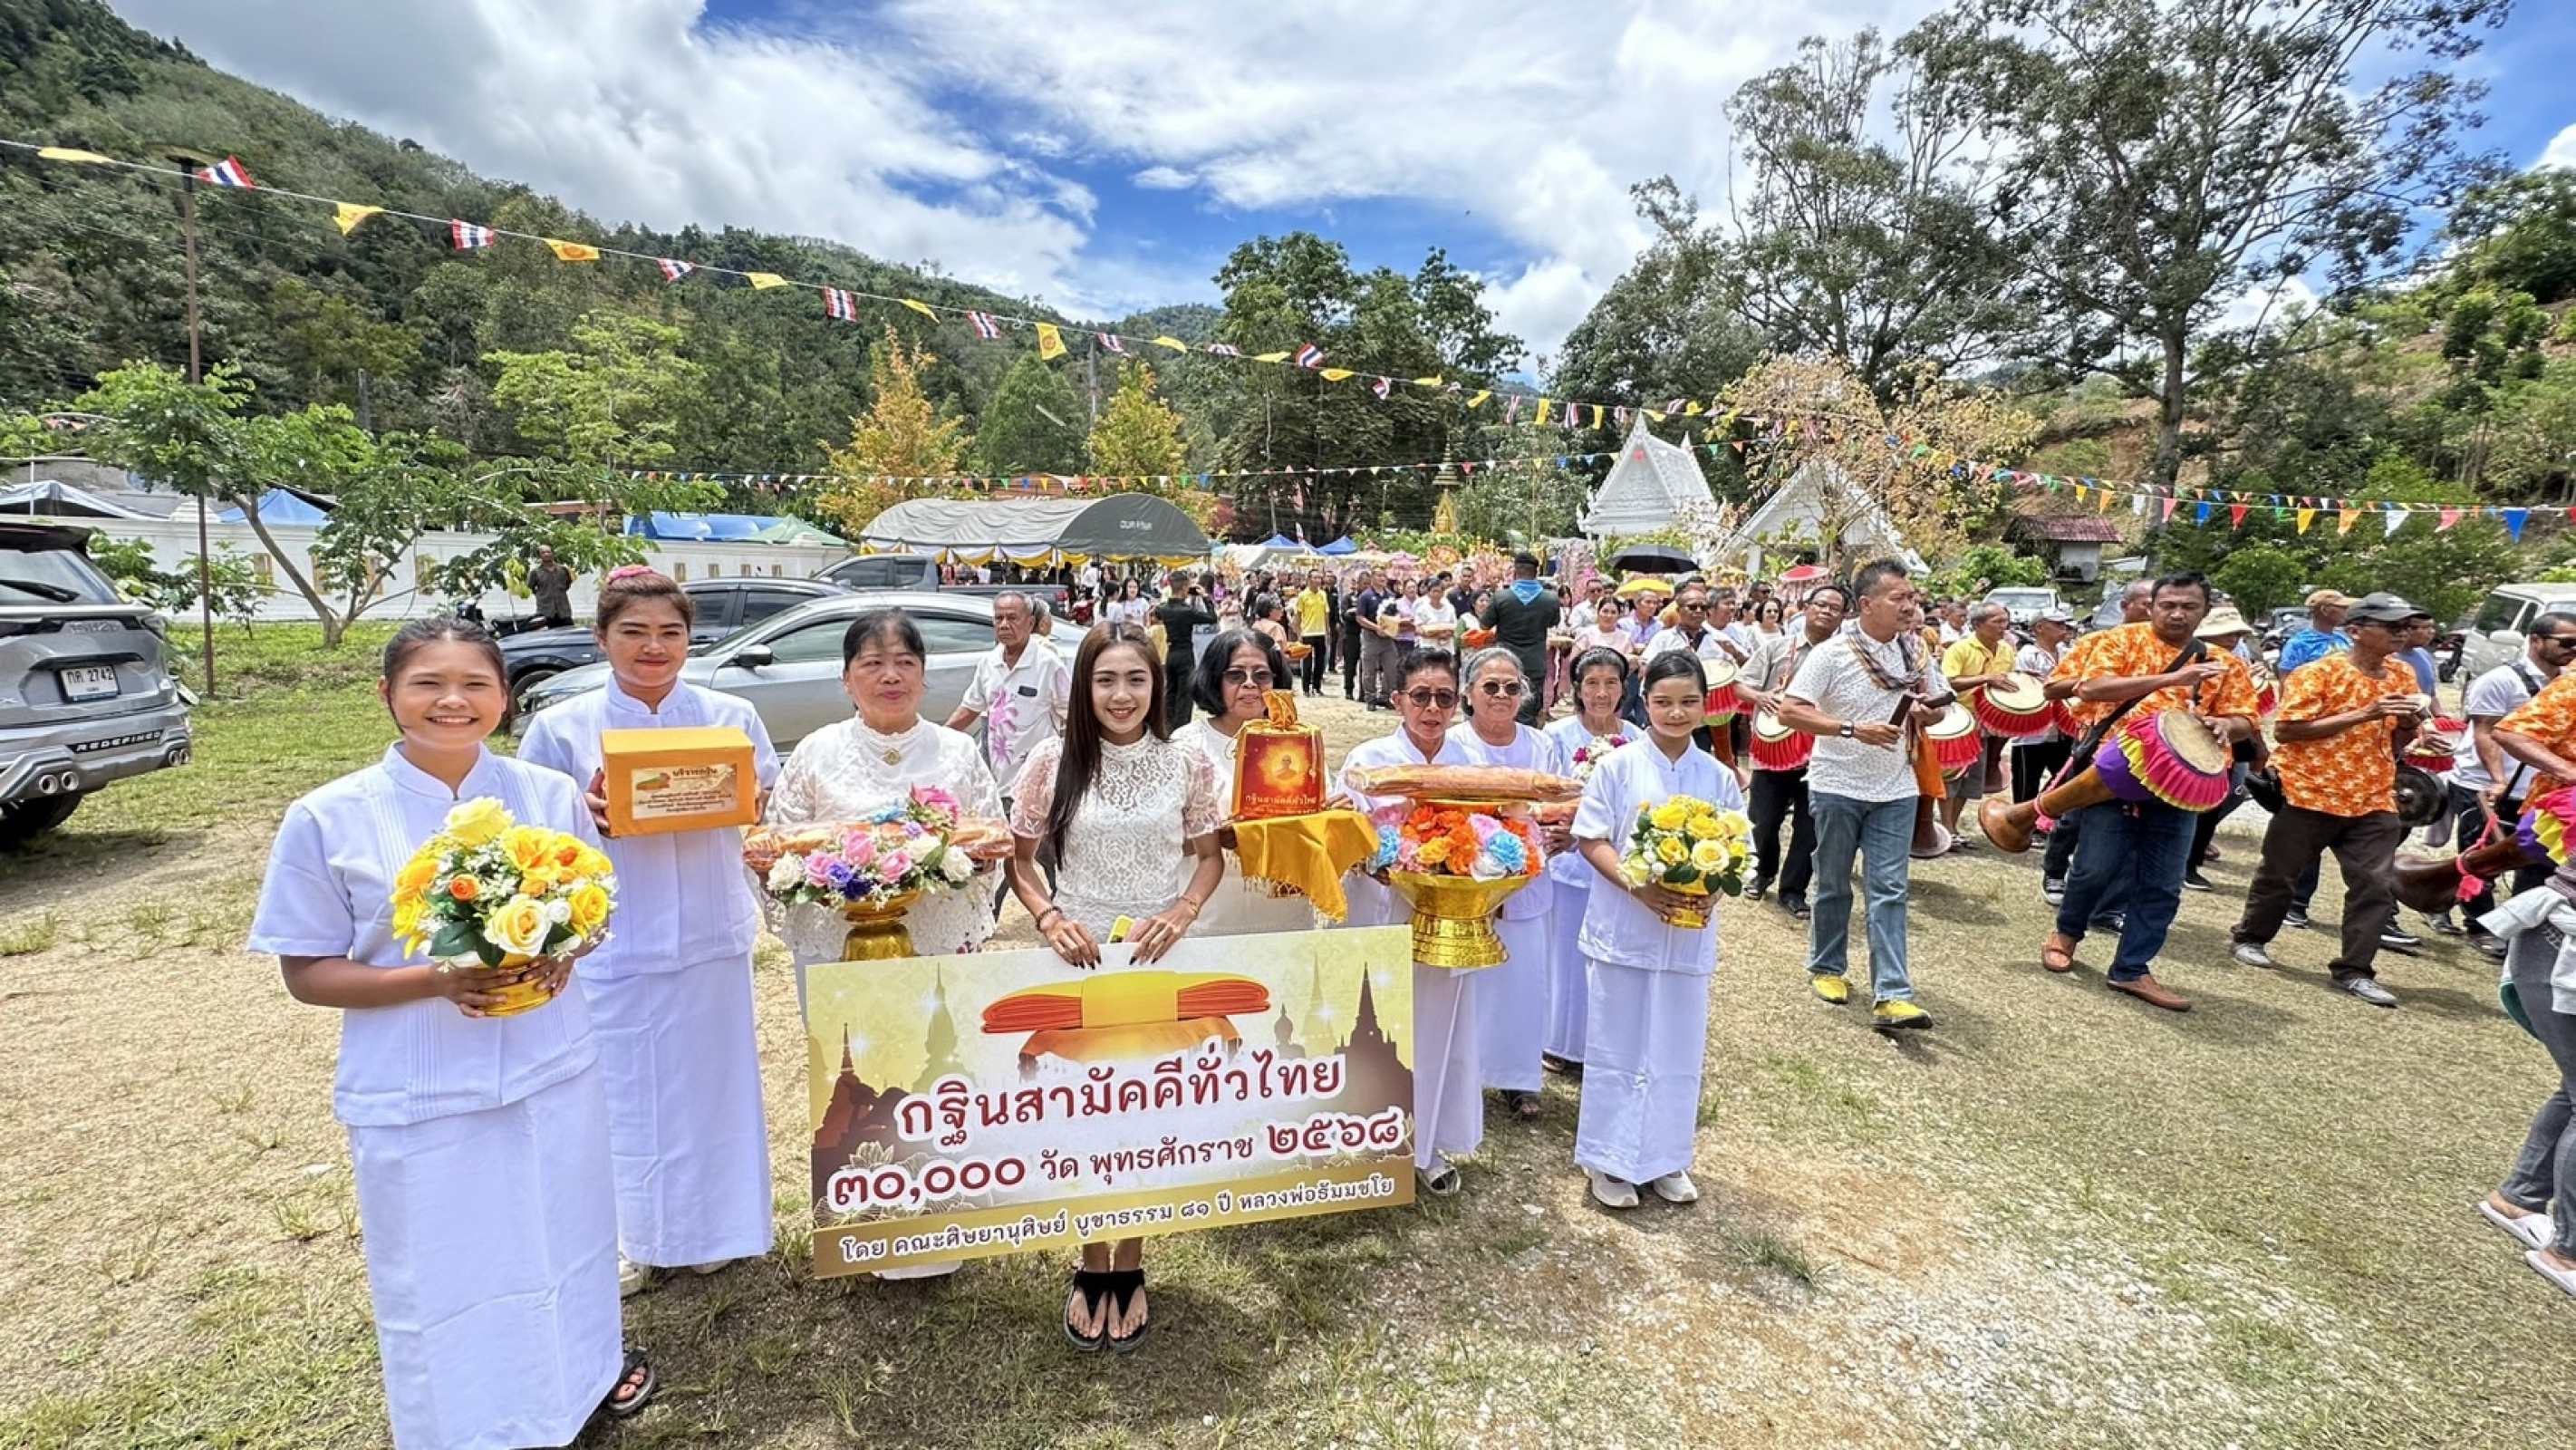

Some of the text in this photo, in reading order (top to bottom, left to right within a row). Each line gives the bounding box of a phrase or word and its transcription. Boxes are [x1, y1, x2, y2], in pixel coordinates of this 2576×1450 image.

[87, 668, 114, 682] 2742
[76, 730, 161, 751] REDEFINED
[901, 1041, 1340, 1146] กฐินสามัคคีทั่วไทย
[834, 1113, 1399, 1206] ๓๐,๐๐๐ วัด พุทธศักราช ๒๕๖๘
[842, 1174, 1393, 1260] โดย คณะศิษยานุศิษย์ บูชาธรรม ๘๑ ปี หลวงพ่อธัมมชโย
